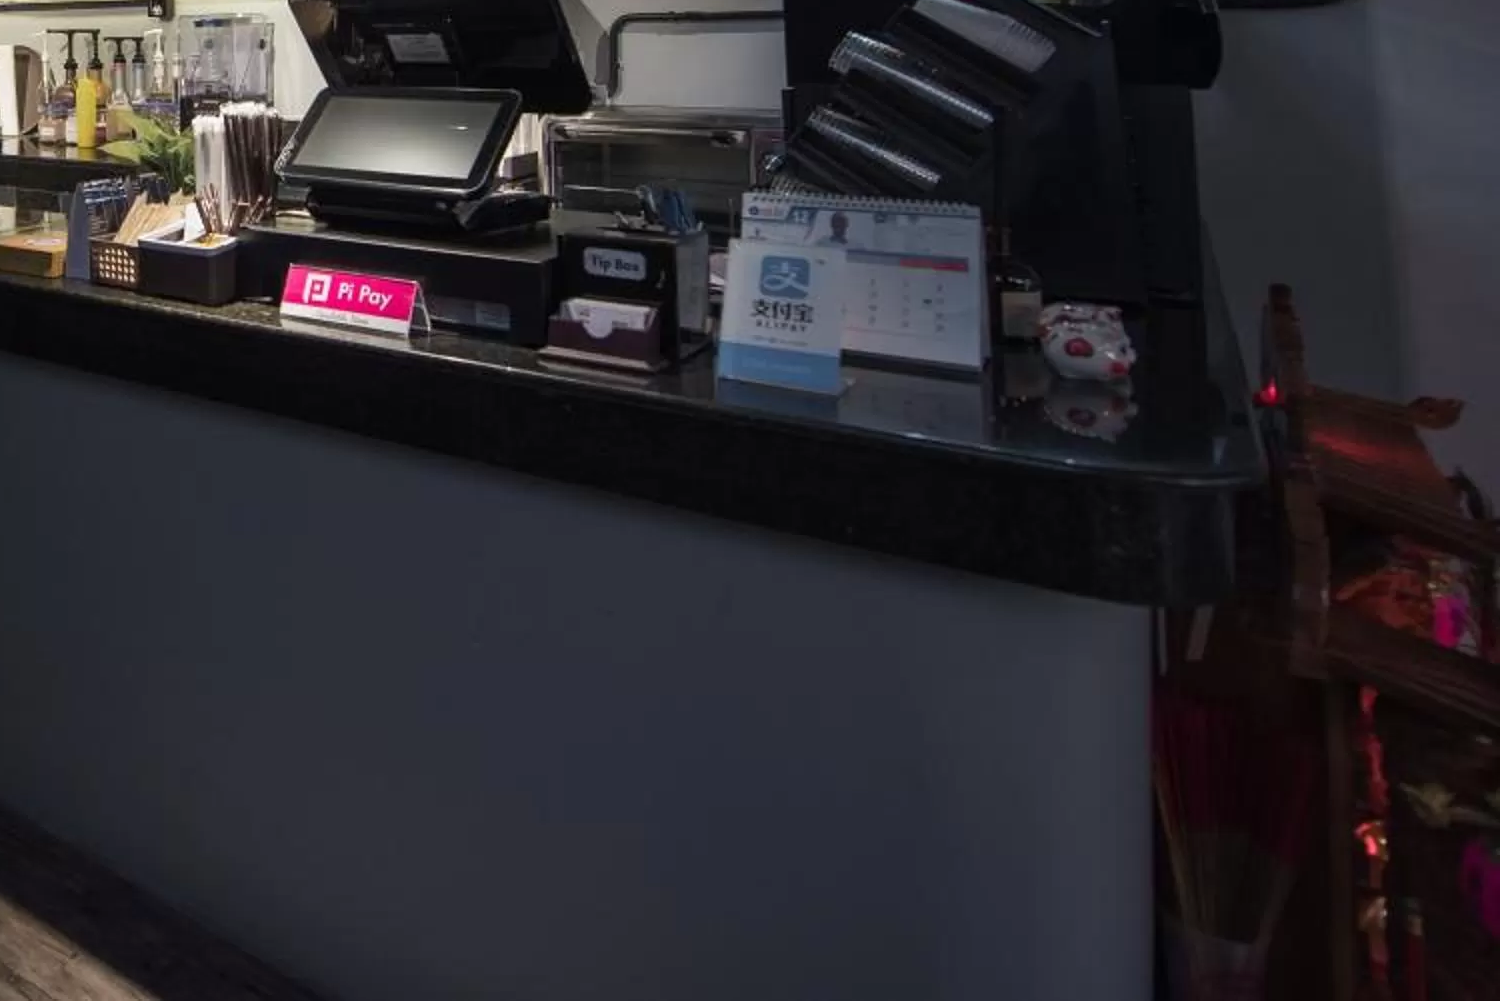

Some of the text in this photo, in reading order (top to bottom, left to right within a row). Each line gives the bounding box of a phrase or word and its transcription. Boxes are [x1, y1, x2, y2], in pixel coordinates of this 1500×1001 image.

[592, 254, 612, 272] Tip
[337, 281, 355, 302] Pi
[358, 285, 393, 311] Pay
[751, 299, 814, 323] 支付宝
